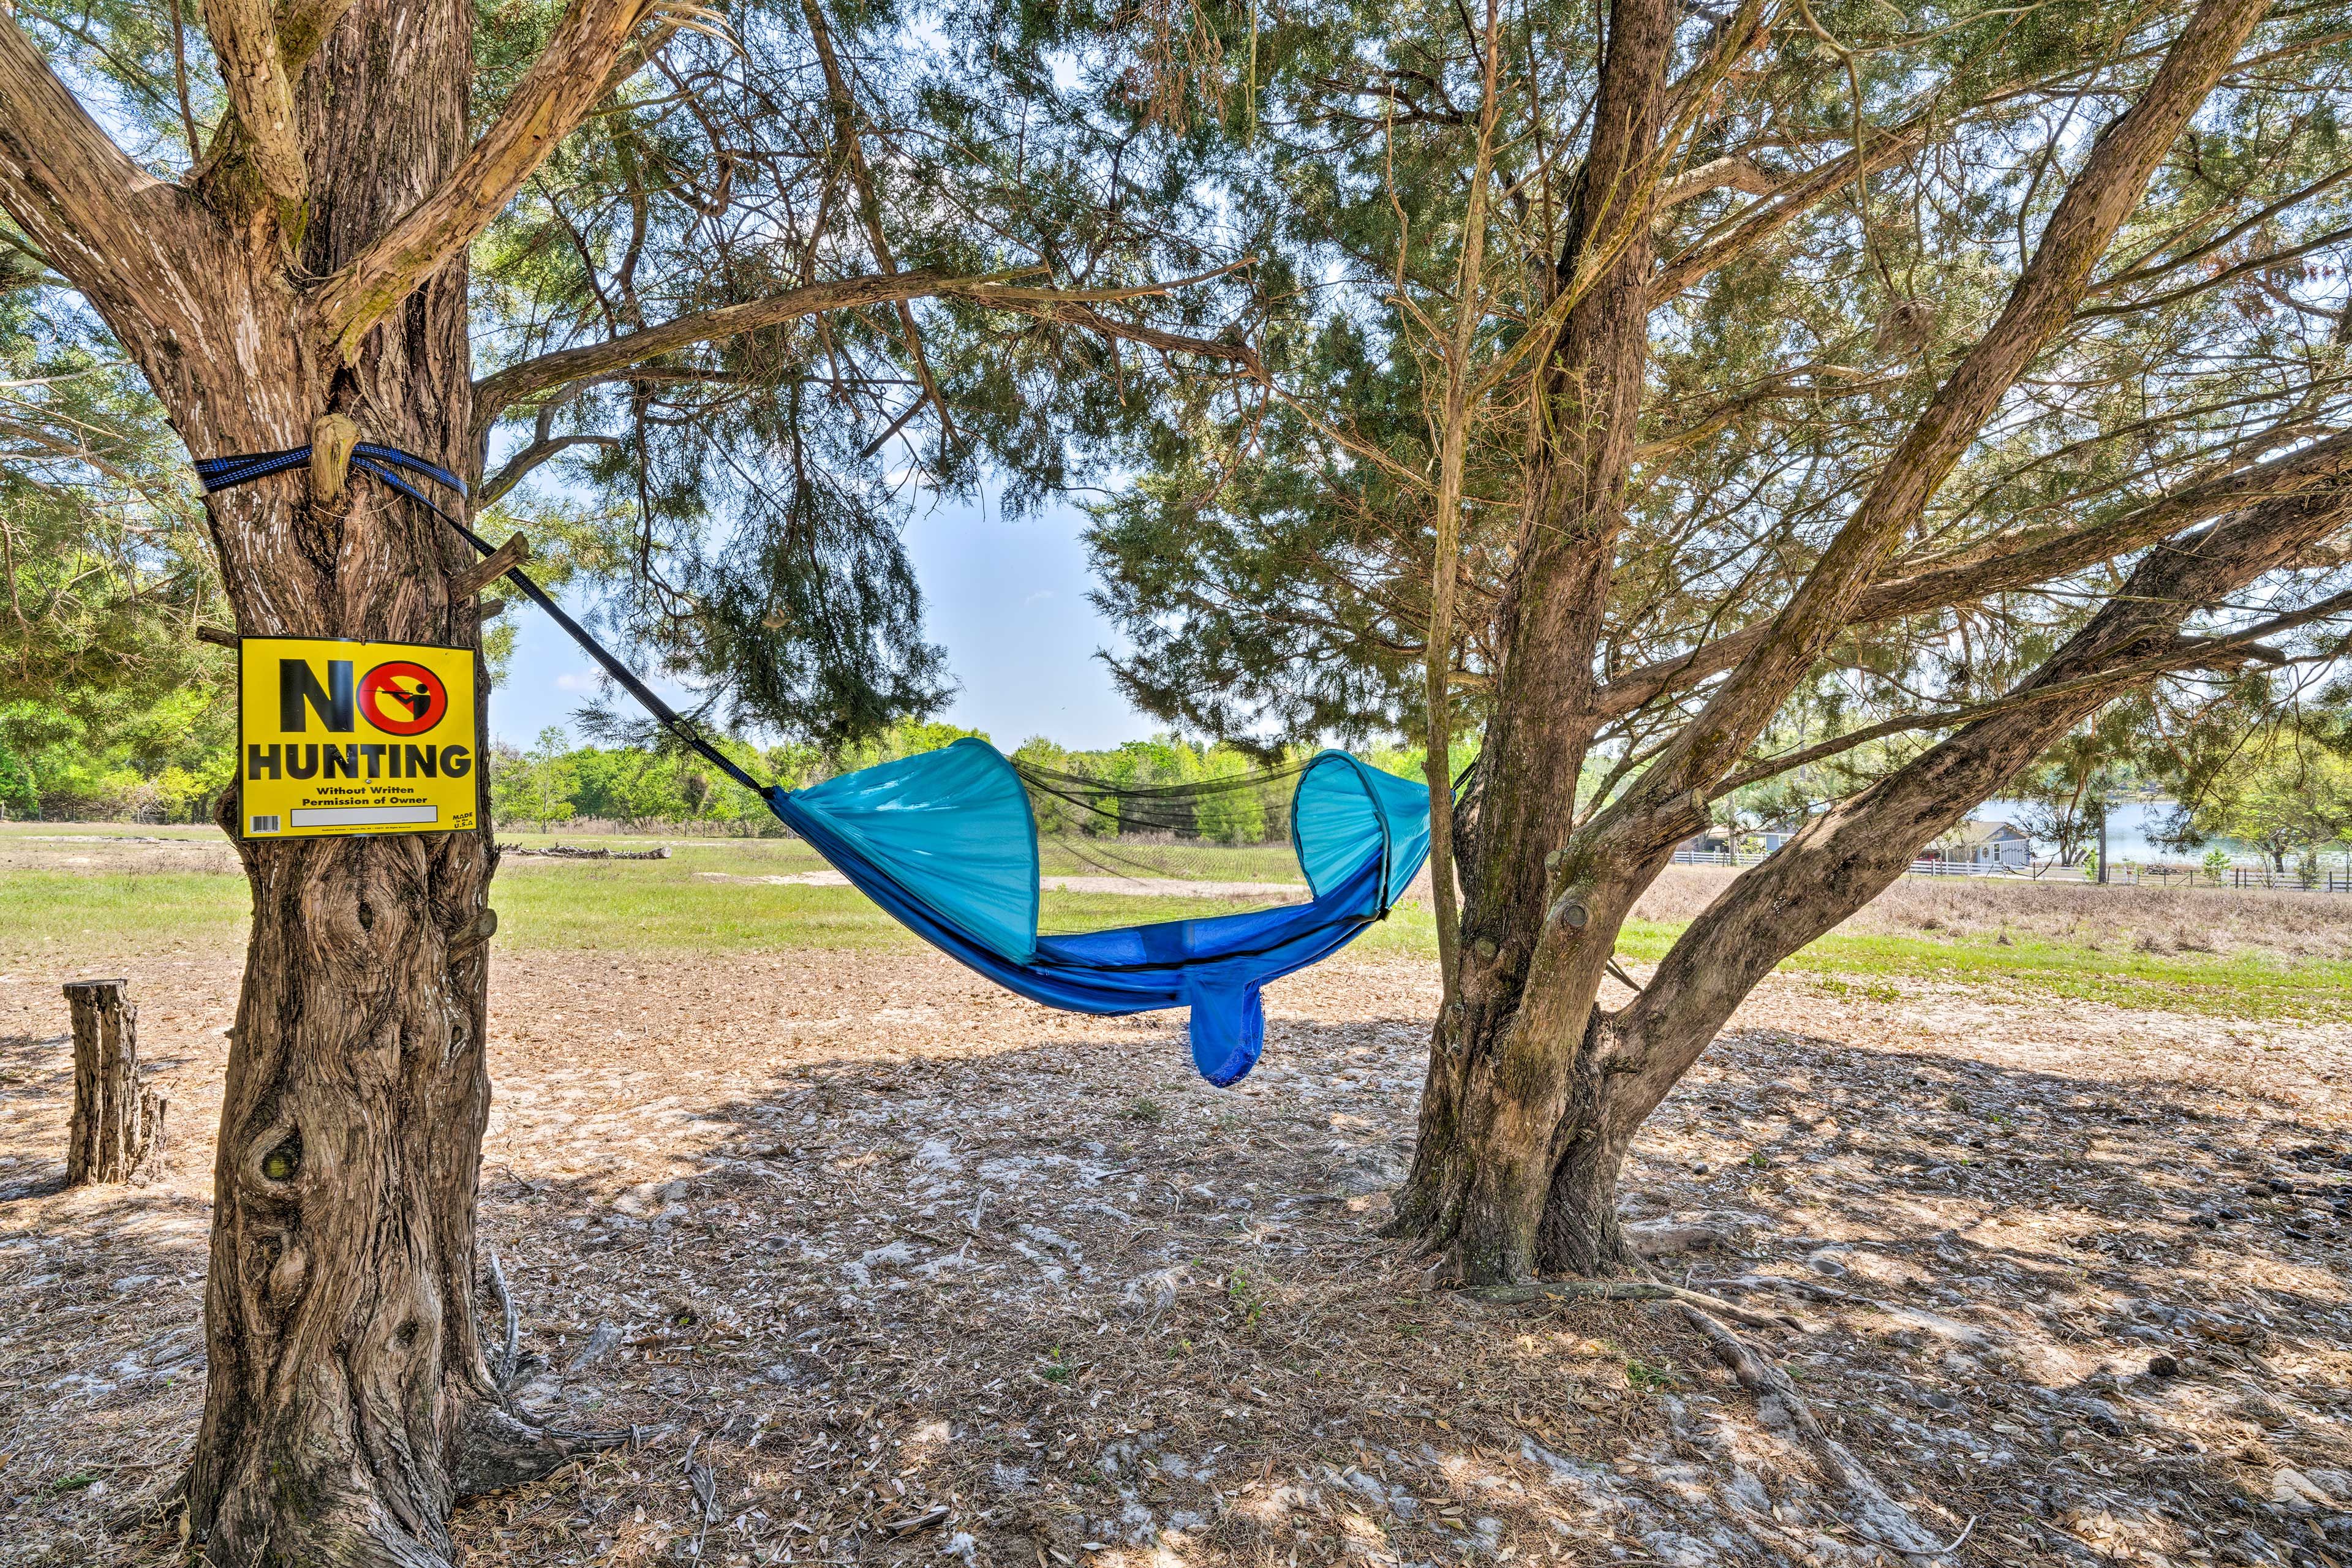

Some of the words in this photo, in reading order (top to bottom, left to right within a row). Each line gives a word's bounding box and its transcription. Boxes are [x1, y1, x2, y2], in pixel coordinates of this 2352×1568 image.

[279, 658, 448, 736] NO
[248, 743, 472, 780] HUNTING
[302, 797, 369, 806] Permission
[453, 812, 473, 820] MADE
